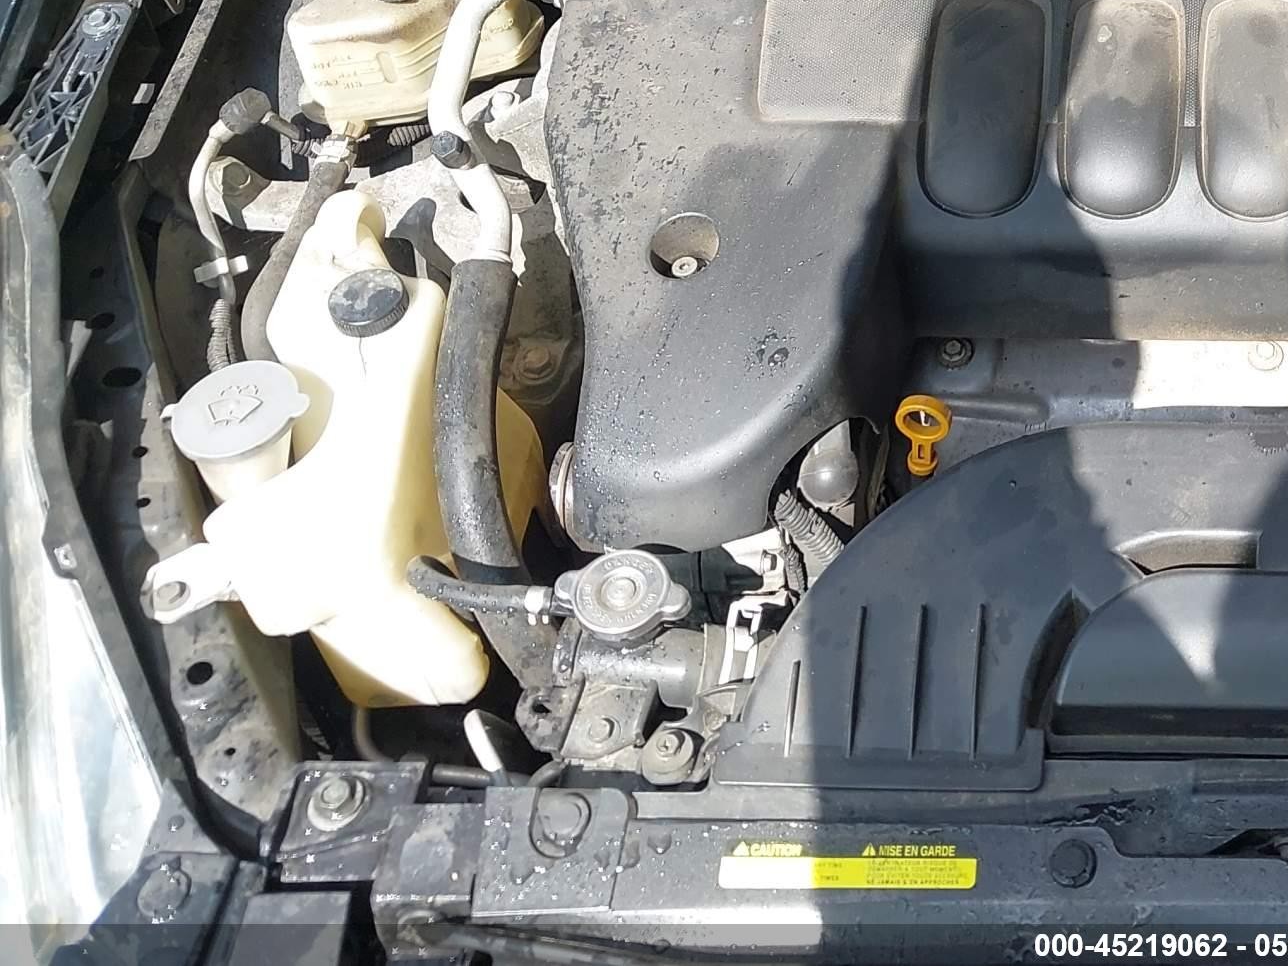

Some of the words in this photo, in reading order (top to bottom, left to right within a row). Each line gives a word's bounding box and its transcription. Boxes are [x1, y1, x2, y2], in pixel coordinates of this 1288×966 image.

[750, 842, 803, 857] CAUTION
[878, 845, 903, 857] MISE
[904, 845, 918, 857] EN
[920, 845, 956, 857] GARDE
